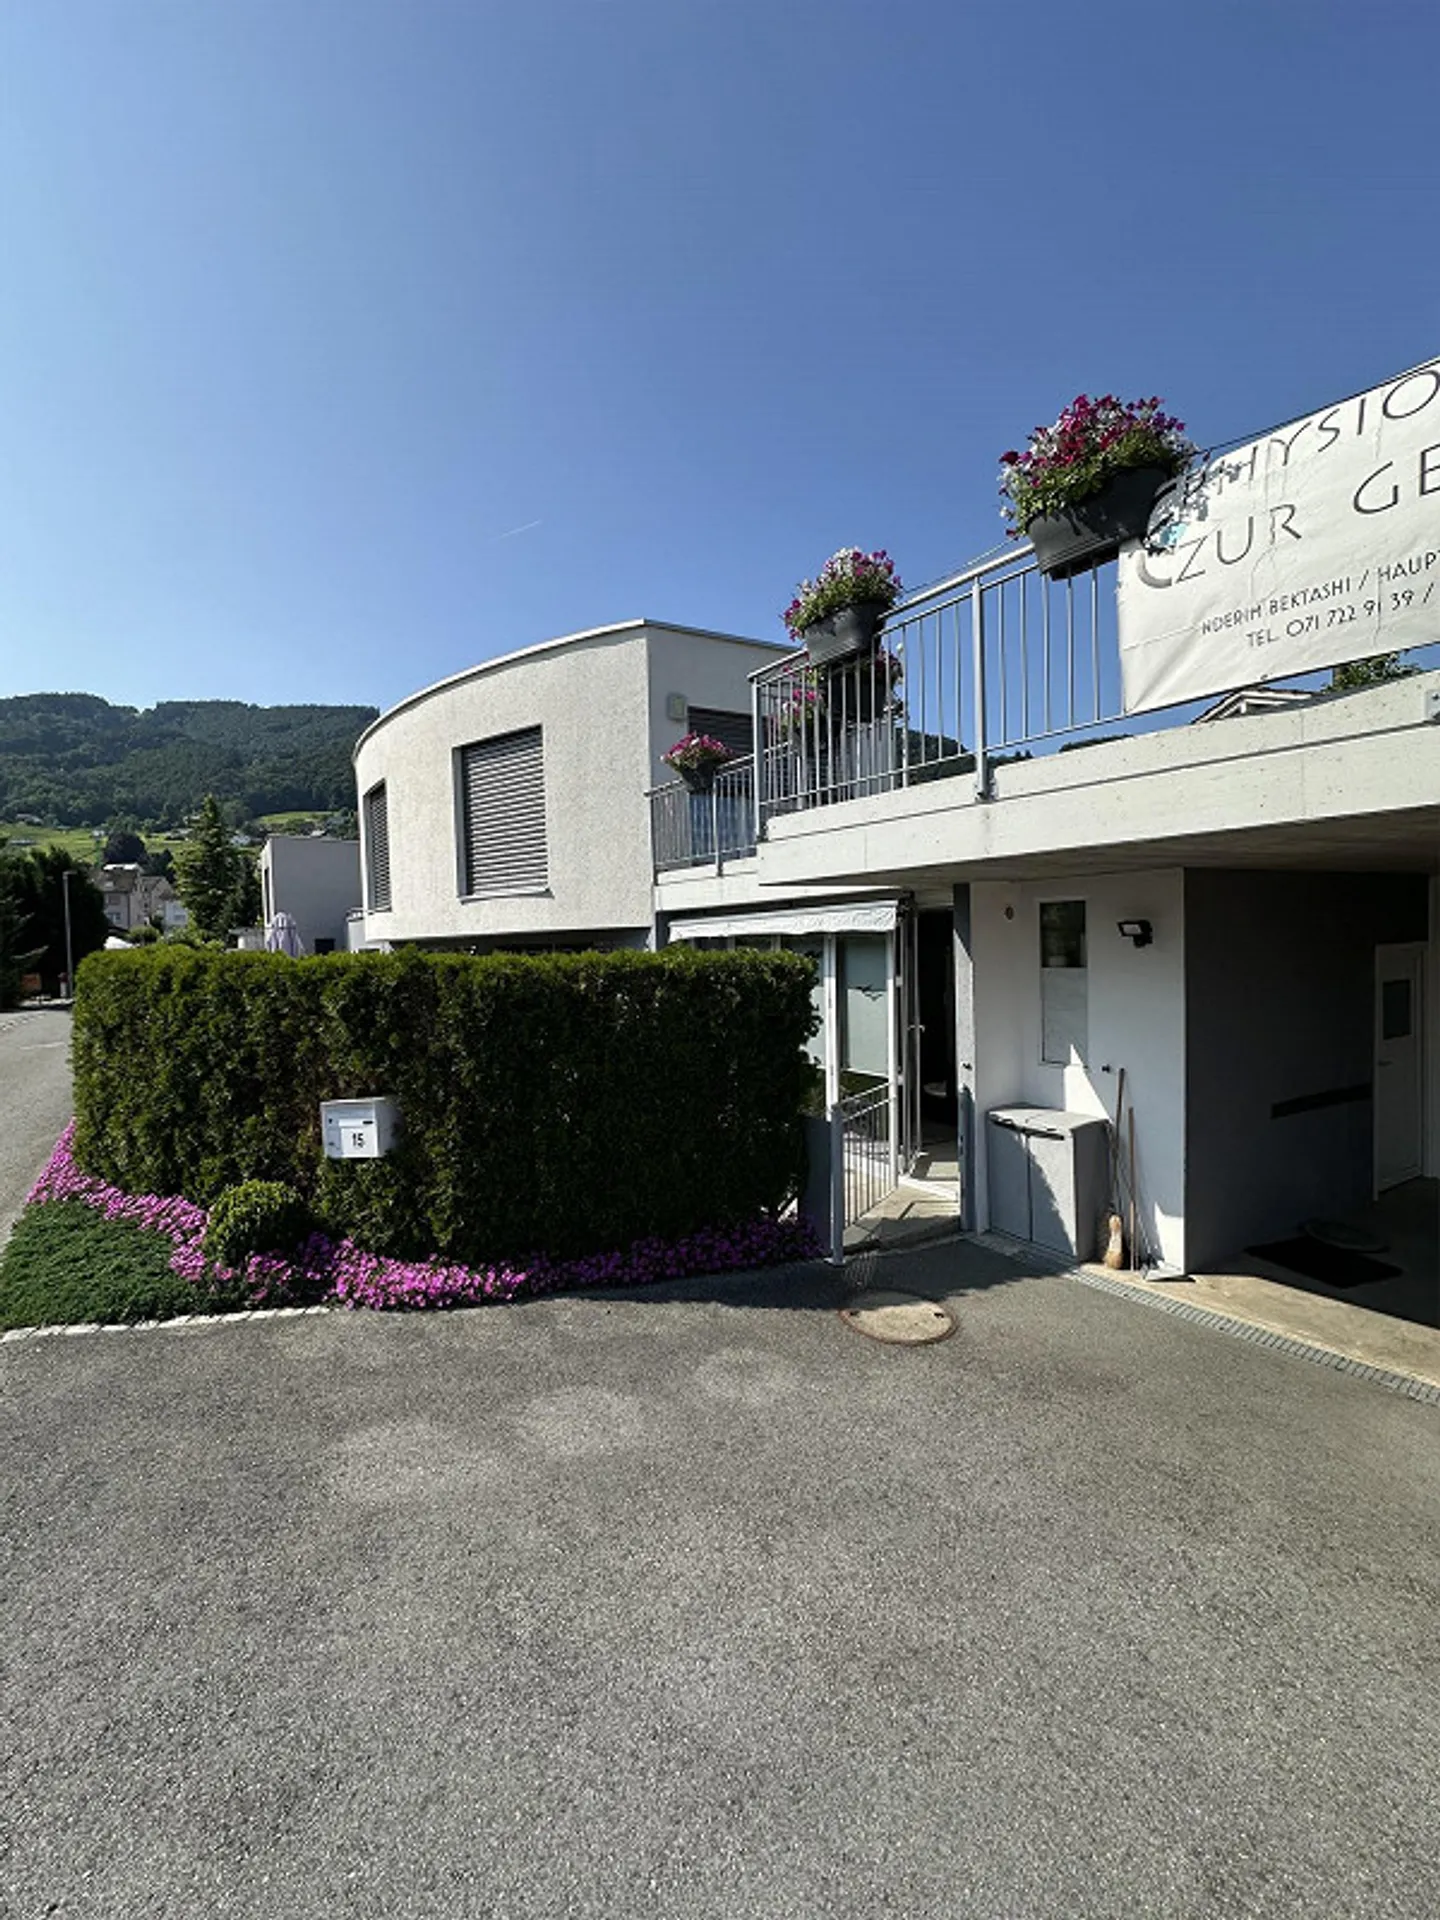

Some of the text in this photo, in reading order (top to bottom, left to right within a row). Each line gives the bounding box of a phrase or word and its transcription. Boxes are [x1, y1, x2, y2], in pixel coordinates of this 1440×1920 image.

[1176, 504, 1302, 583] ZUR
[1269, 577, 1351, 615] BEKTASHI
[1358, 569, 1369, 591] /
[1377, 549, 1440, 582] HAUP
[1286, 614, 1320, 637] 071
[1327, 606, 1357, 628] 722
[1390, 588, 1415, 611] 39
[1423, 582, 1434, 604] /
[352, 1132, 365, 1149] 15
